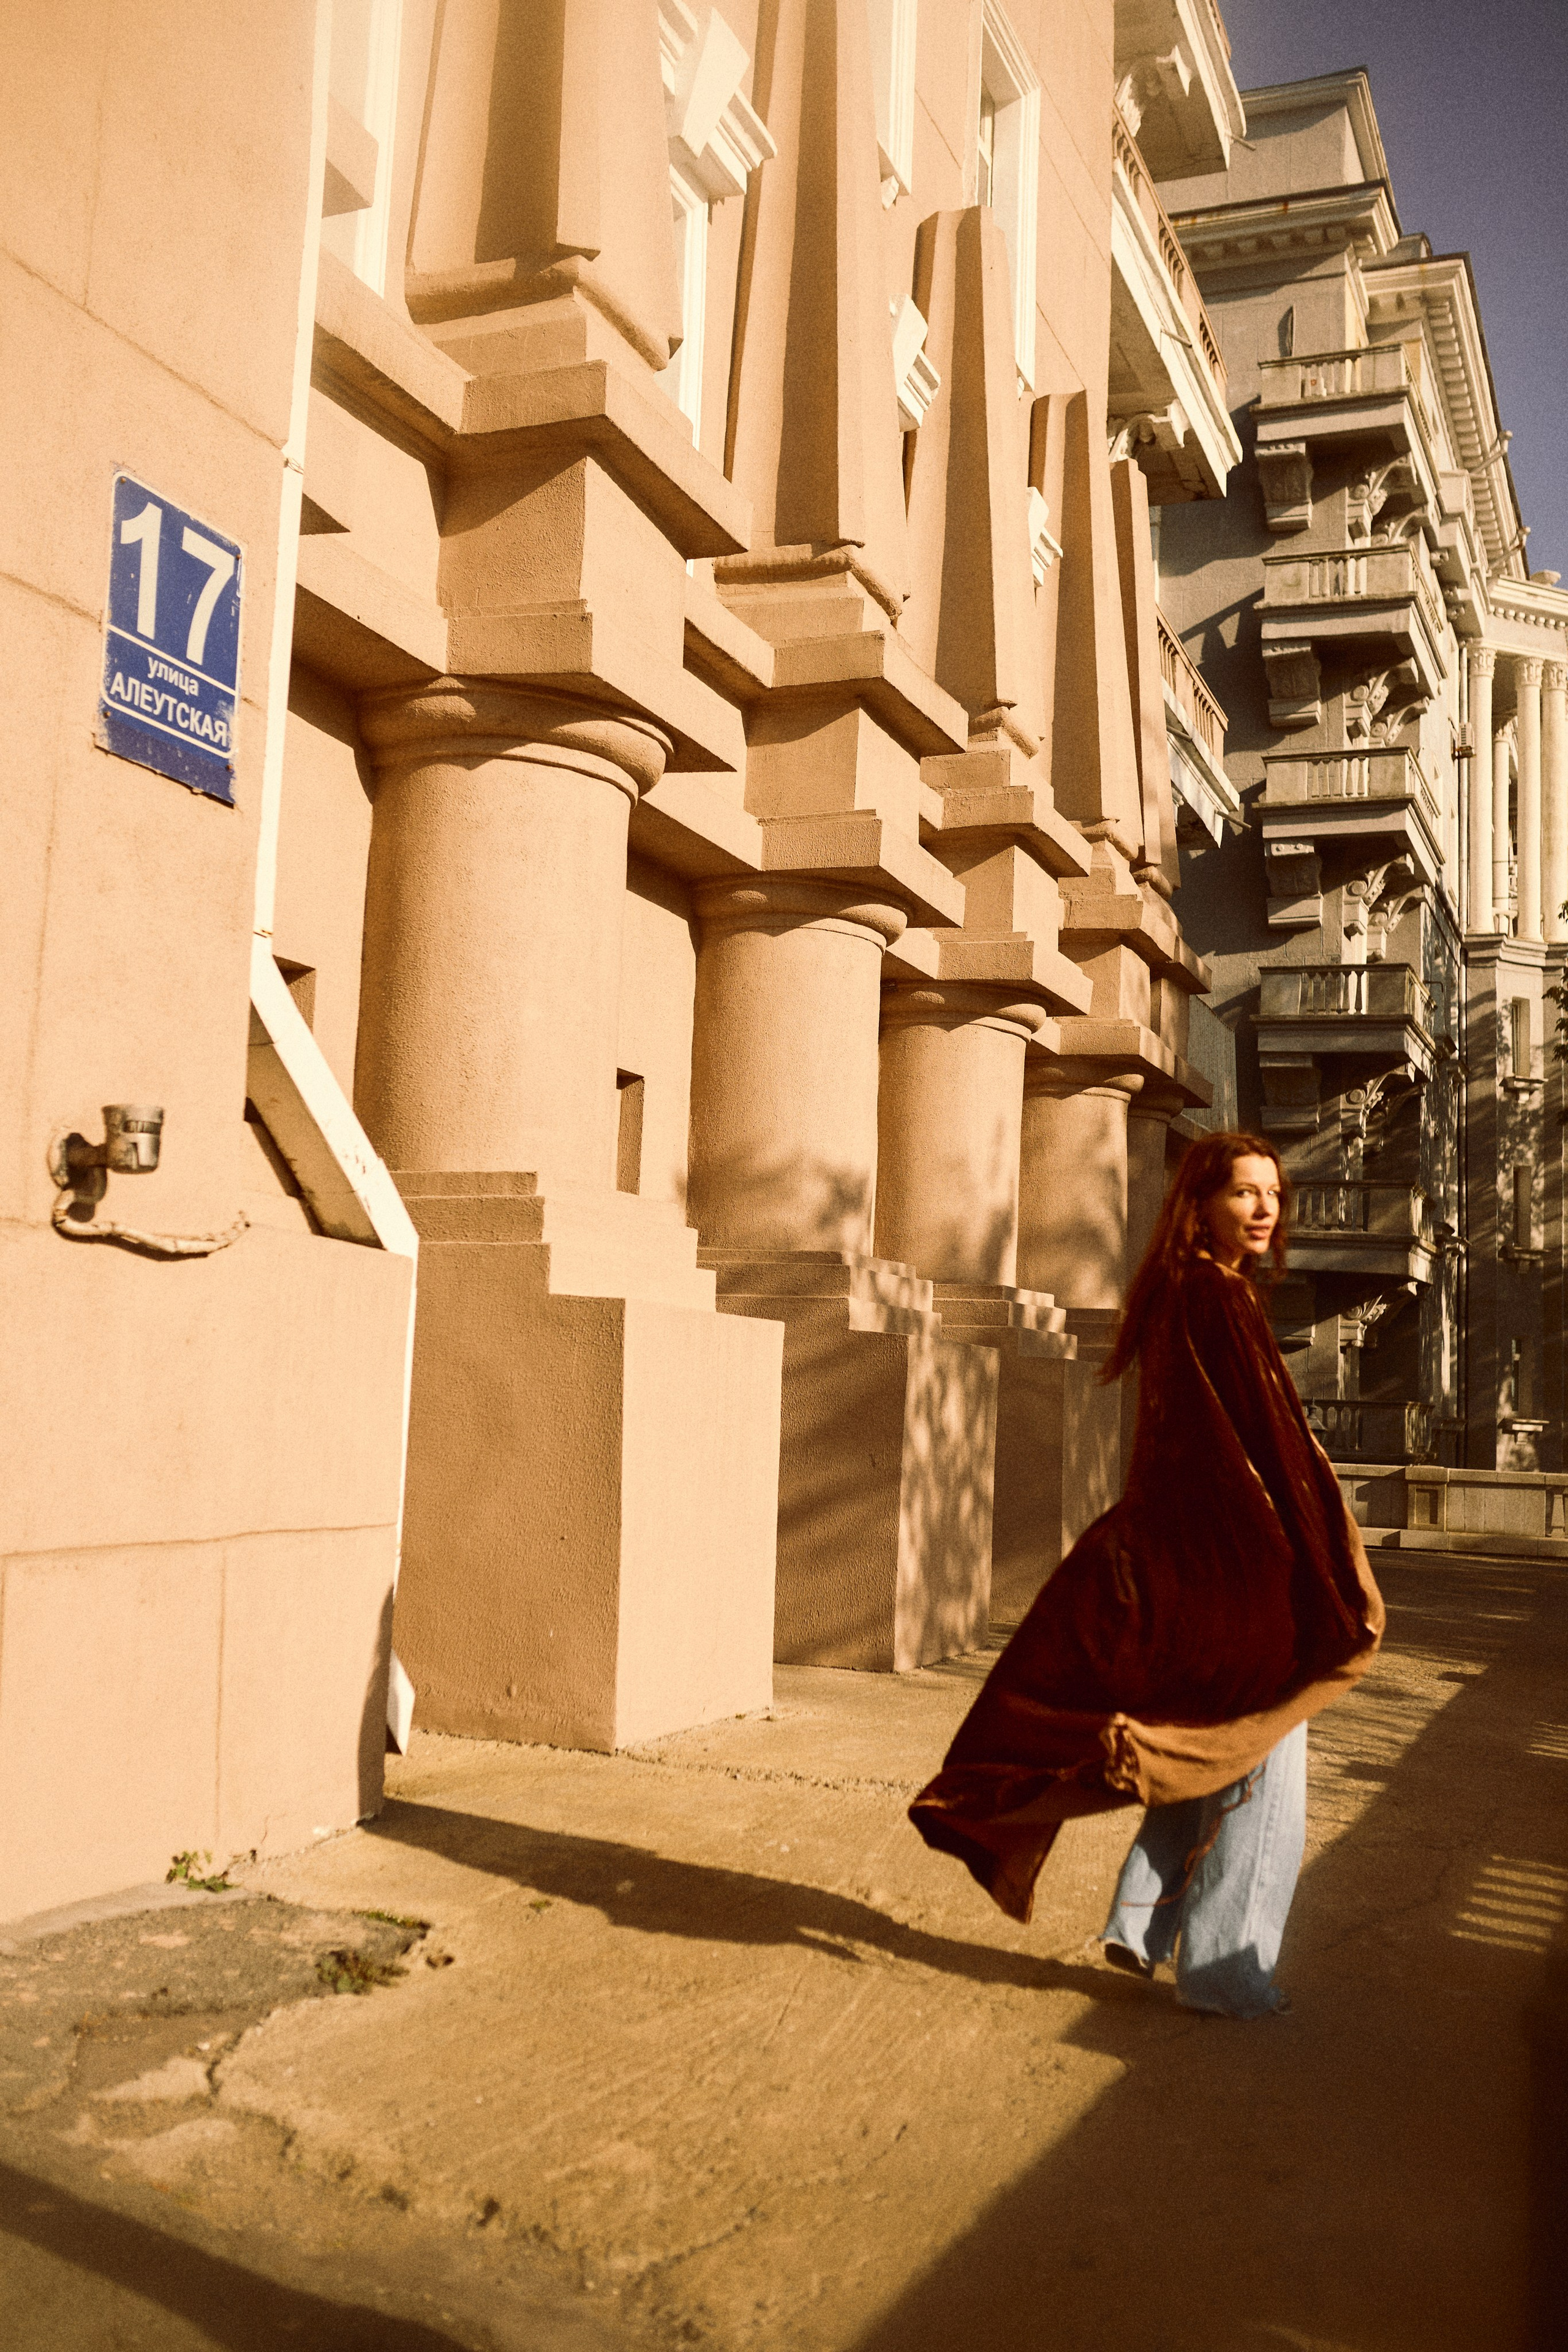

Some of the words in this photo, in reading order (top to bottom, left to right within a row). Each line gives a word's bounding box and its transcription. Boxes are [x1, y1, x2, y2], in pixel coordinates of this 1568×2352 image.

[121, 502, 235, 666] 17
[110, 672, 227, 747] АЛЕУТСКАЯ
[148, 657, 199, 696] улица
